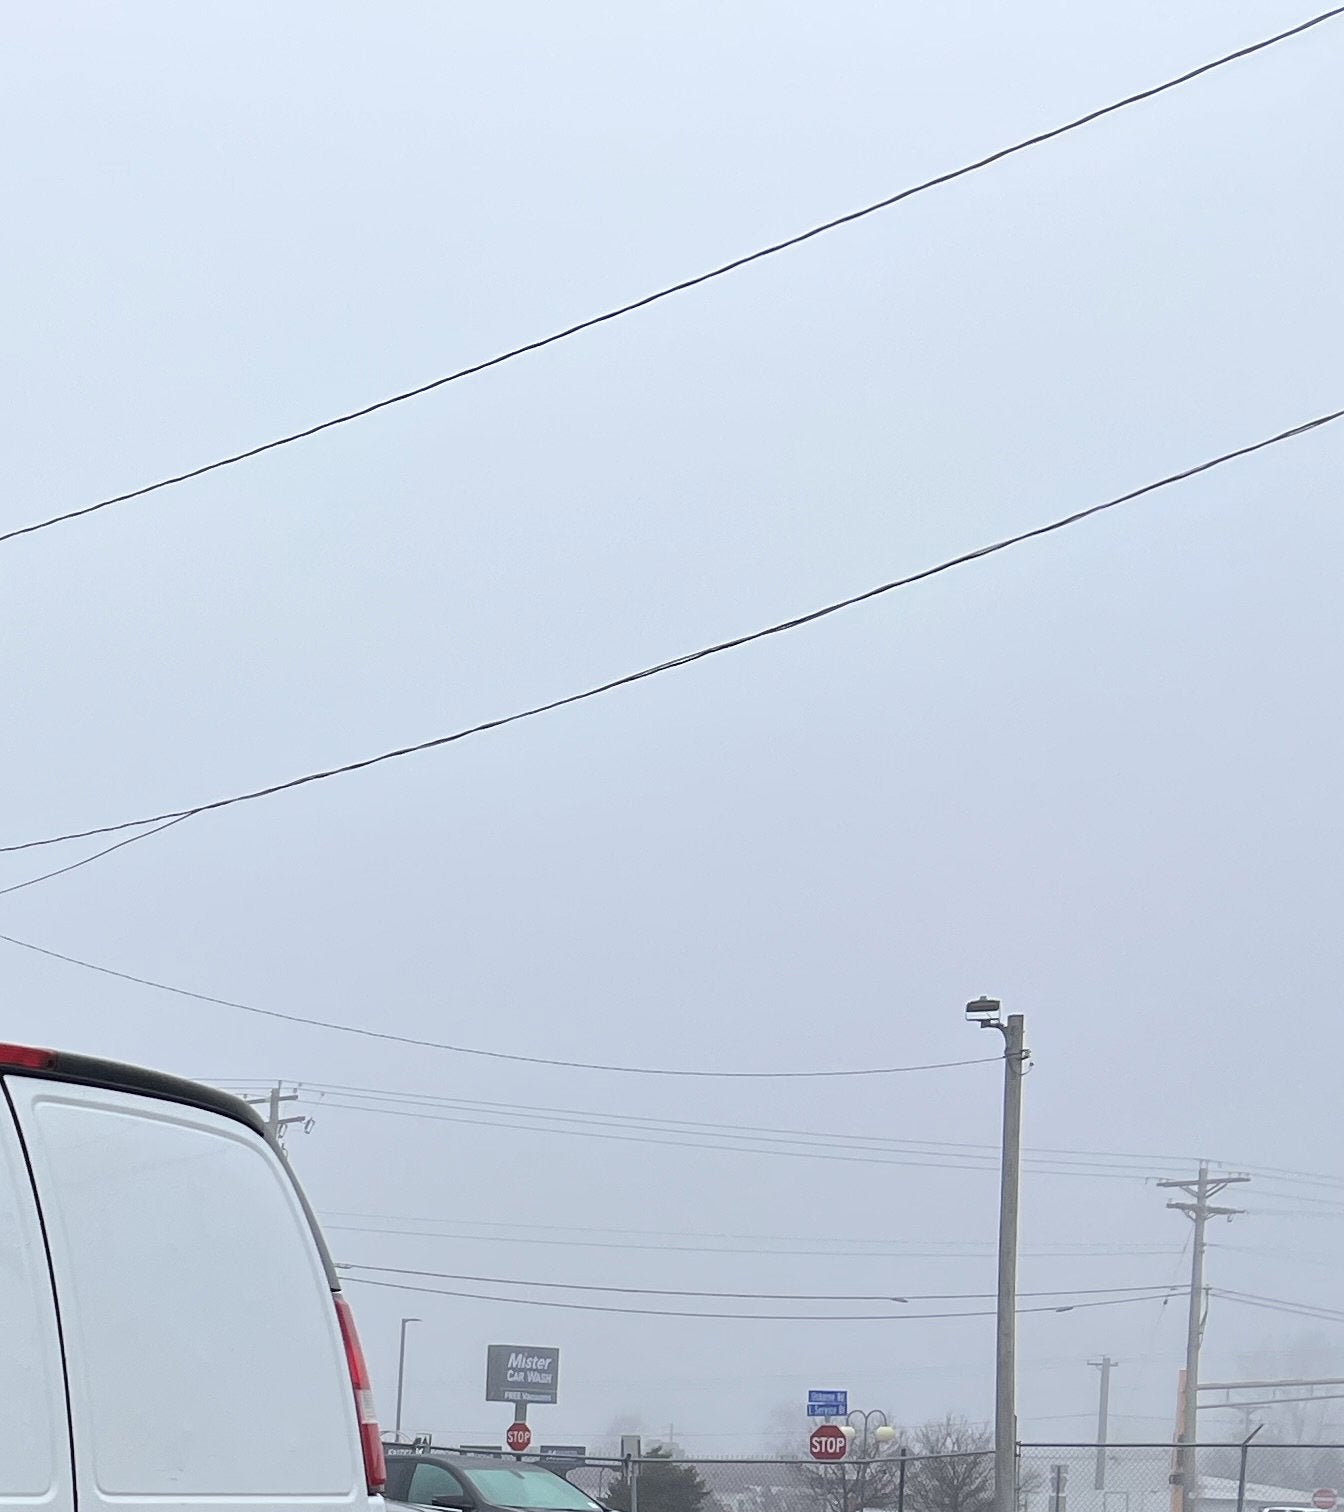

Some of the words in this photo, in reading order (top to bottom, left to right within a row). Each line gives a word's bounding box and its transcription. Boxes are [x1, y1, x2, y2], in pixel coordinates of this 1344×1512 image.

[507, 1352, 552, 1370] Mister
[507, 1369, 524, 1382] CAR
[526, 1370, 552, 1384] WASH
[504, 1391, 520, 1400] FREE
[507, 1431, 530, 1443] STOP
[811, 1437, 845, 1453] STOP
